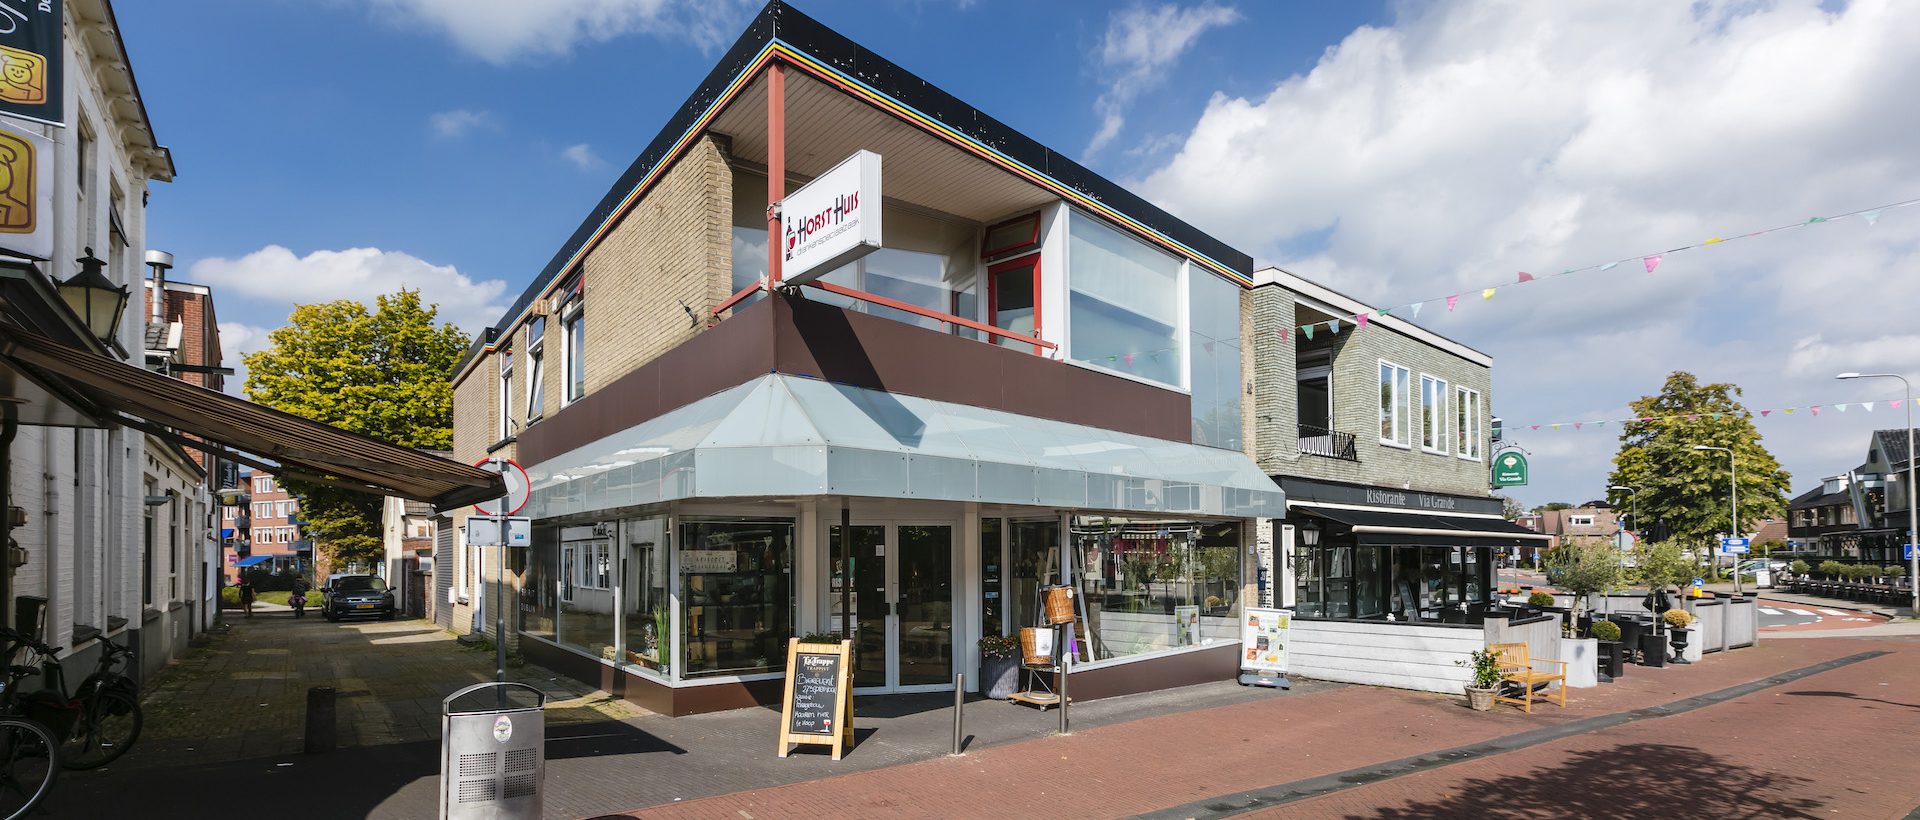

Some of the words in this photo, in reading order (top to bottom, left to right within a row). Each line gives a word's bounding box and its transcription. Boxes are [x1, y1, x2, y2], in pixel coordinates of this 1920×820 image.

[797, 206, 832, 245] HORST
[833, 190, 859, 225] HUIS
[1366, 489, 1406, 506] Ristorante
[1418, 494, 1430, 507] Via
[1431, 495, 1455, 509] Grande
[811, 656, 834, 667] Trappe
